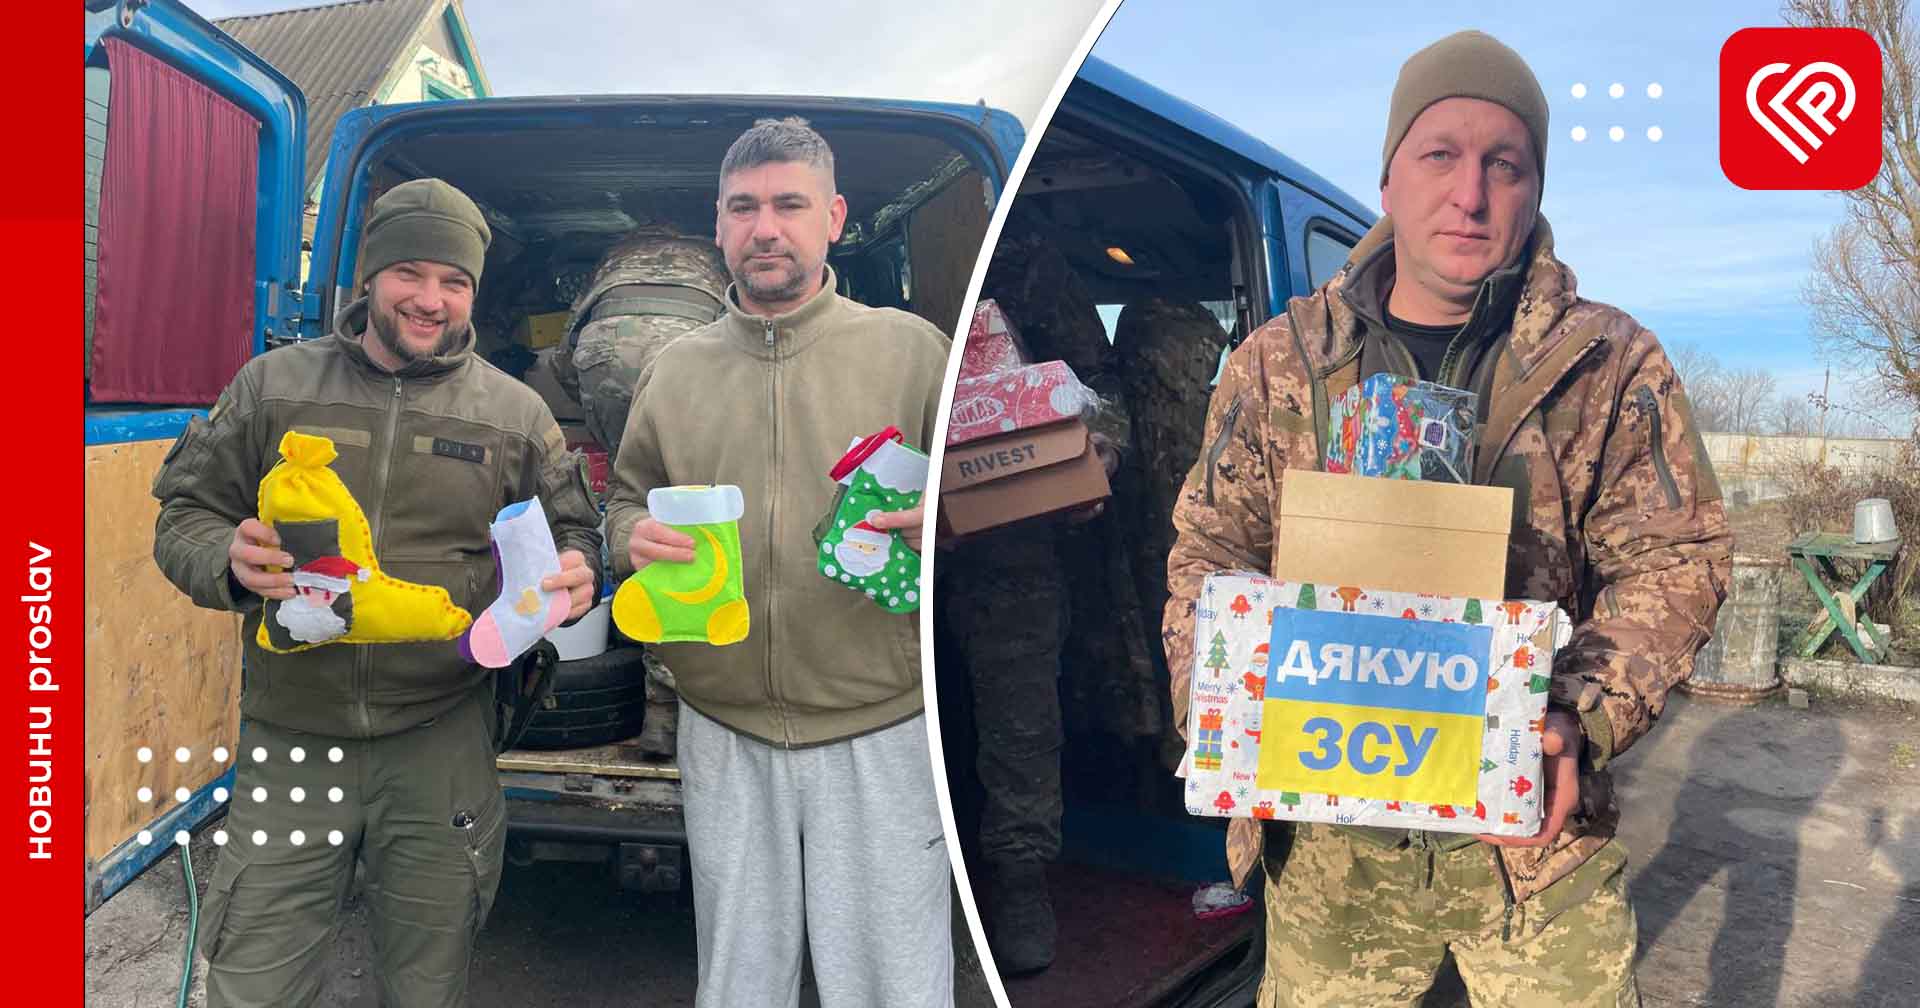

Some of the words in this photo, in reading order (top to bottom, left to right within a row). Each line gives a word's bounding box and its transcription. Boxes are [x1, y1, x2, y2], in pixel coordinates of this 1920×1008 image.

[958, 443, 1036, 478] RIVEST
[1276, 639, 1479, 692] ДЯКУЮ
[1198, 681, 1221, 695] Merry
[1298, 716, 1439, 777] ЗСУ
[1507, 728, 1521, 765] Holiday
